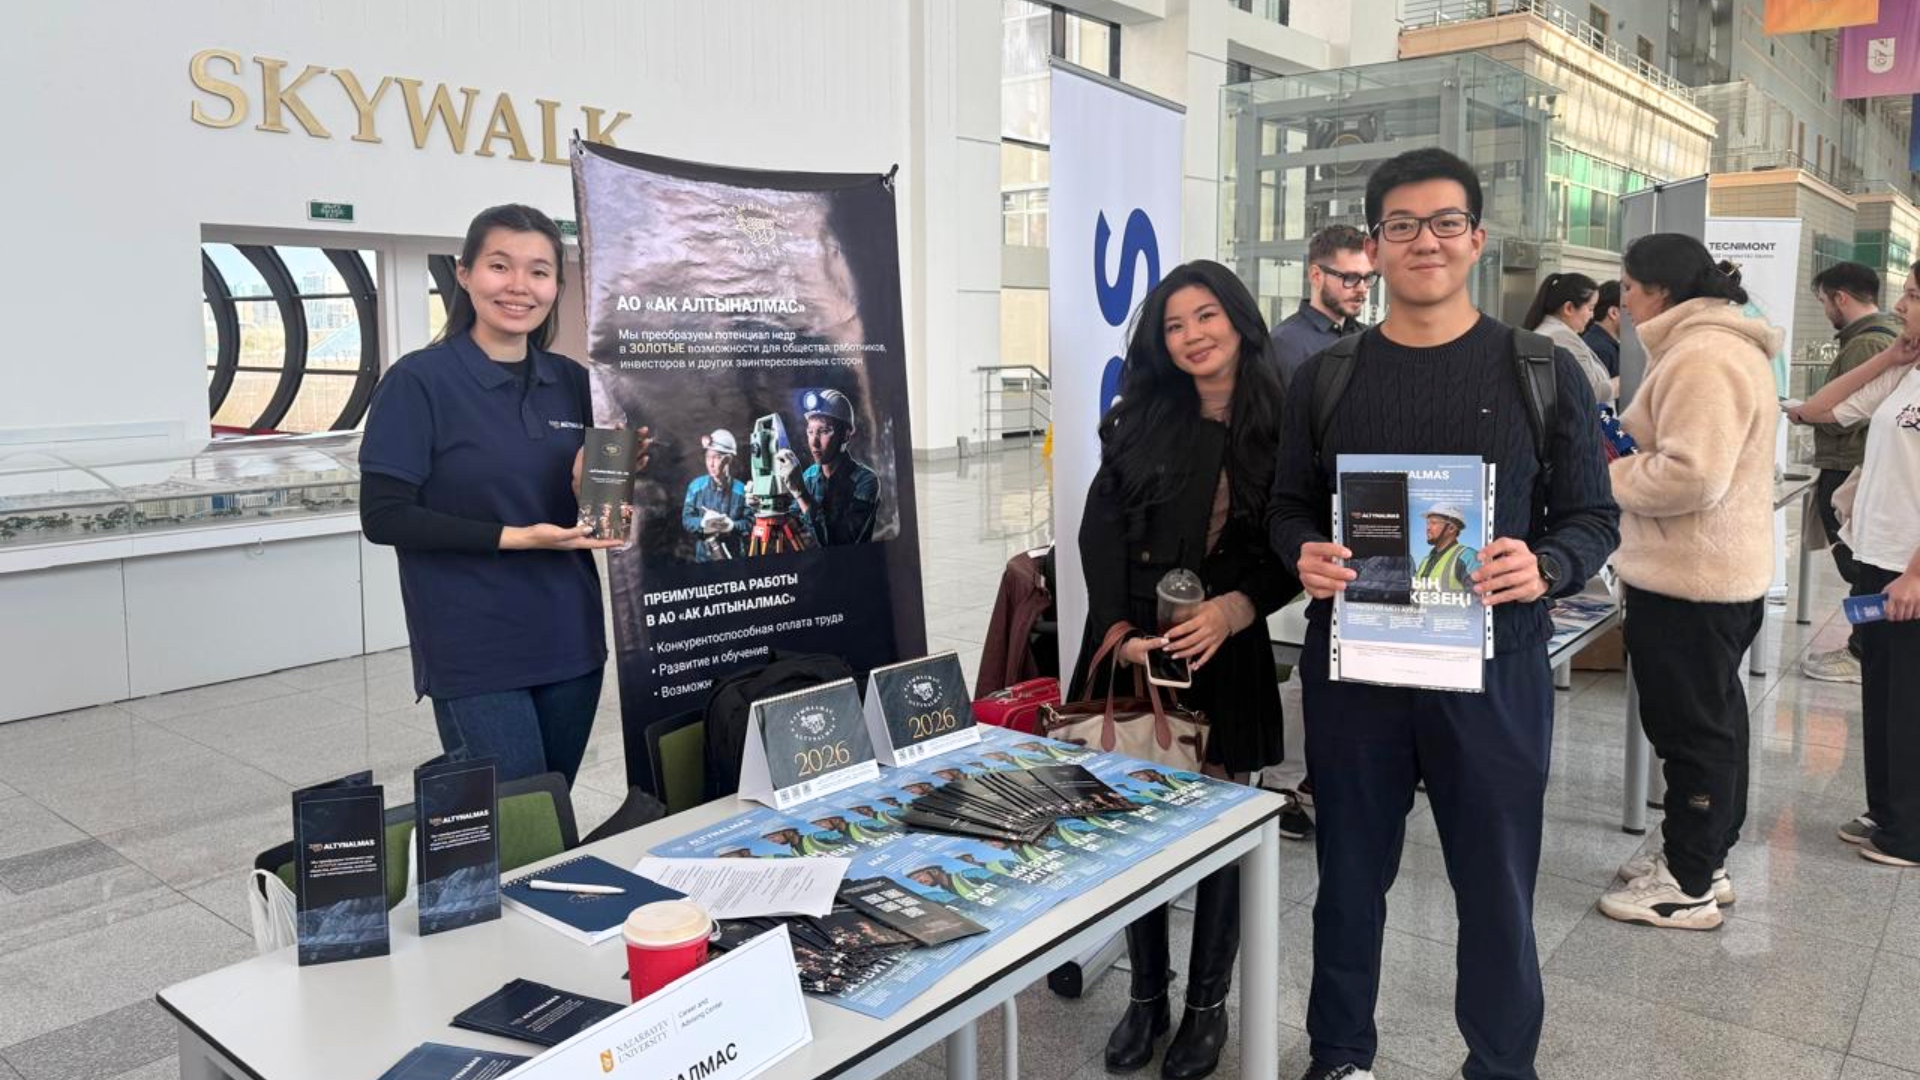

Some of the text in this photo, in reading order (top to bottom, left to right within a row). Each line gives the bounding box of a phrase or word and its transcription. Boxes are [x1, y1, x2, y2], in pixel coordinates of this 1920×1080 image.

[189, 48, 632, 166] SKYWALK
[1709, 242, 1776, 251] TECNIMONT
[616, 295, 806, 313] АО «АК АЛТЫНАЛМАС»
[618, 328, 796, 342] Мы преобразуем потенциал недр
[619, 346, 626, 354] в
[629, 342, 685, 354] ЗОЛОТЫЕ
[688, 344, 760, 354] возможности
[762, 344, 780, 354] для
[833, 343, 887, 354] работников,
[620, 356, 863, 370] инвесторов и других заинтересованных сторон
[644, 572, 798, 606] ПРЕИМУЩЕСТВА РАБОТЫ
[646, 593, 796, 627] В АО «АК АЛТЫНАЛМАС»
[656, 613, 844, 654] Конкурентоспособная оплата труда
[659, 645, 769, 677] Развитие и обучение
[661, 679, 713, 698] Возможн
[908, 707, 956, 739] 2026
[794, 739, 850, 777] 2026
[442, 809, 490, 824] ALTYNALMAS
[323, 839, 376, 850] ALTYNALMAS
[678, 997, 709, 1018] Career and
[681, 1001, 723, 1028] Advising Center
[616, 1018, 669, 1053] NAZARBAYEV
[618, 1030, 667, 1063] UNIVERSITY
[670, 1042, 738, 1080] ЛМАС
